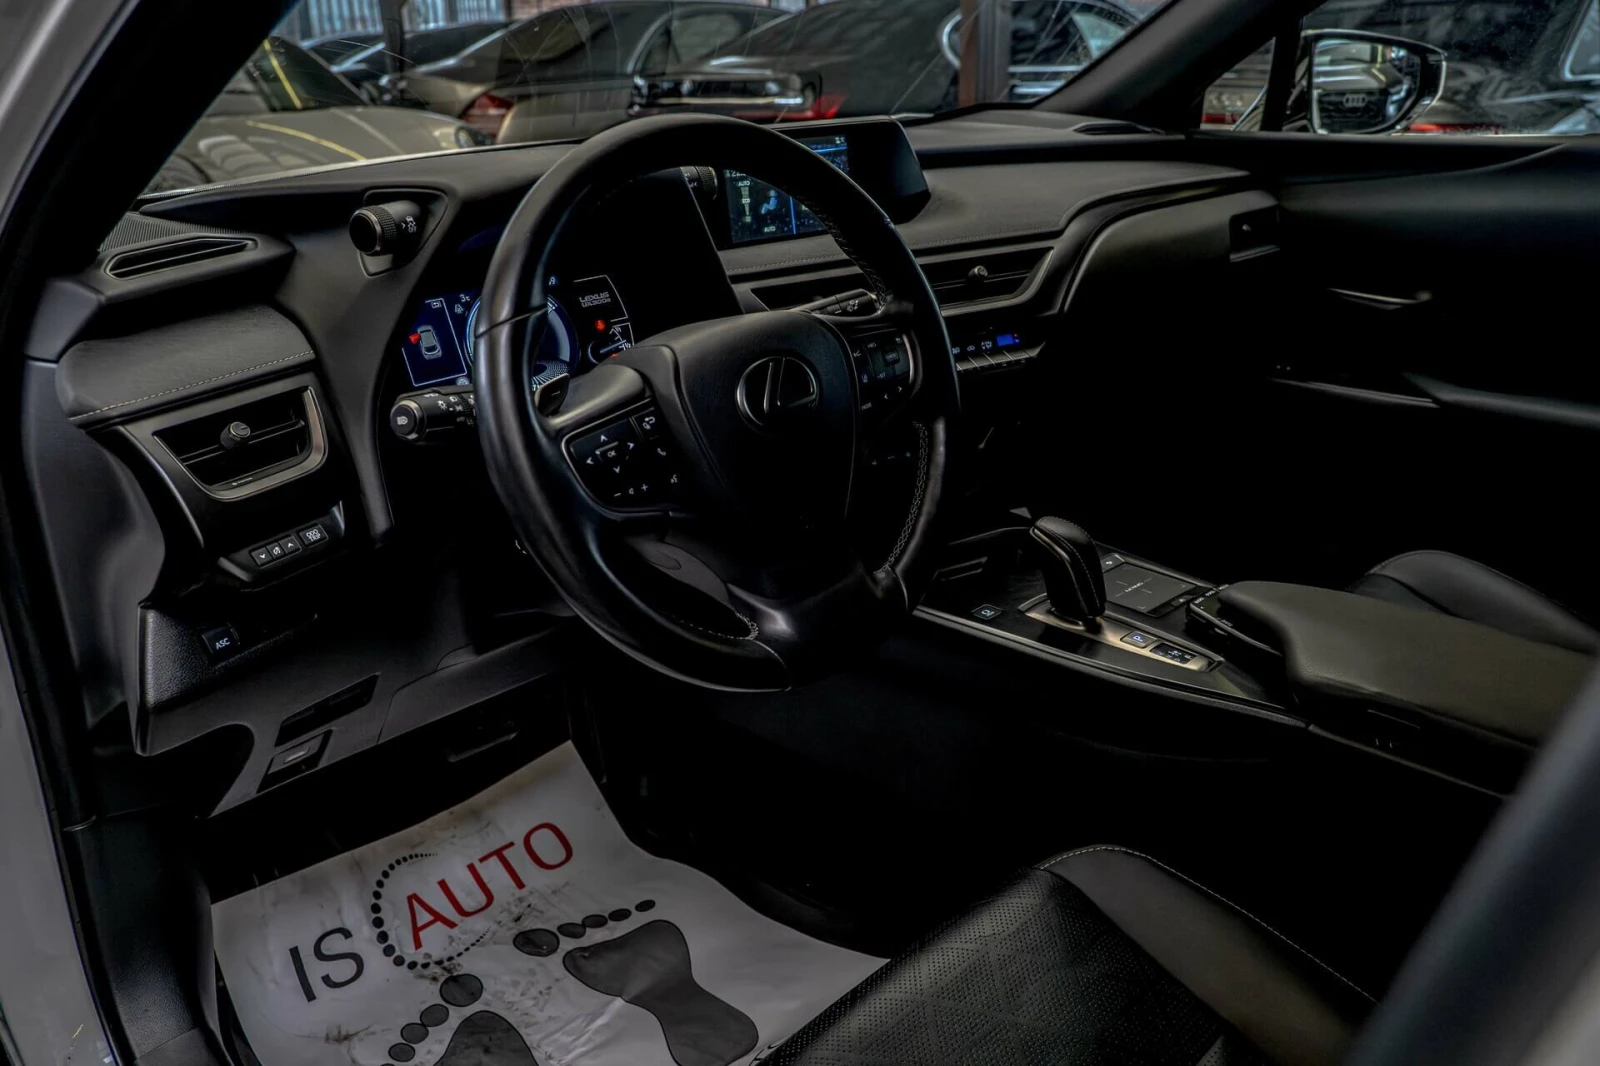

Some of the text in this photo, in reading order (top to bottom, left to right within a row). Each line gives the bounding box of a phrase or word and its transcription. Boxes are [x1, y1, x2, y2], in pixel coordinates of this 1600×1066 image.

[579, 291, 610, 303] LEXUS
[215, 637, 231, 650] ASC
[289, 822, 574, 1003] IS AUTO
